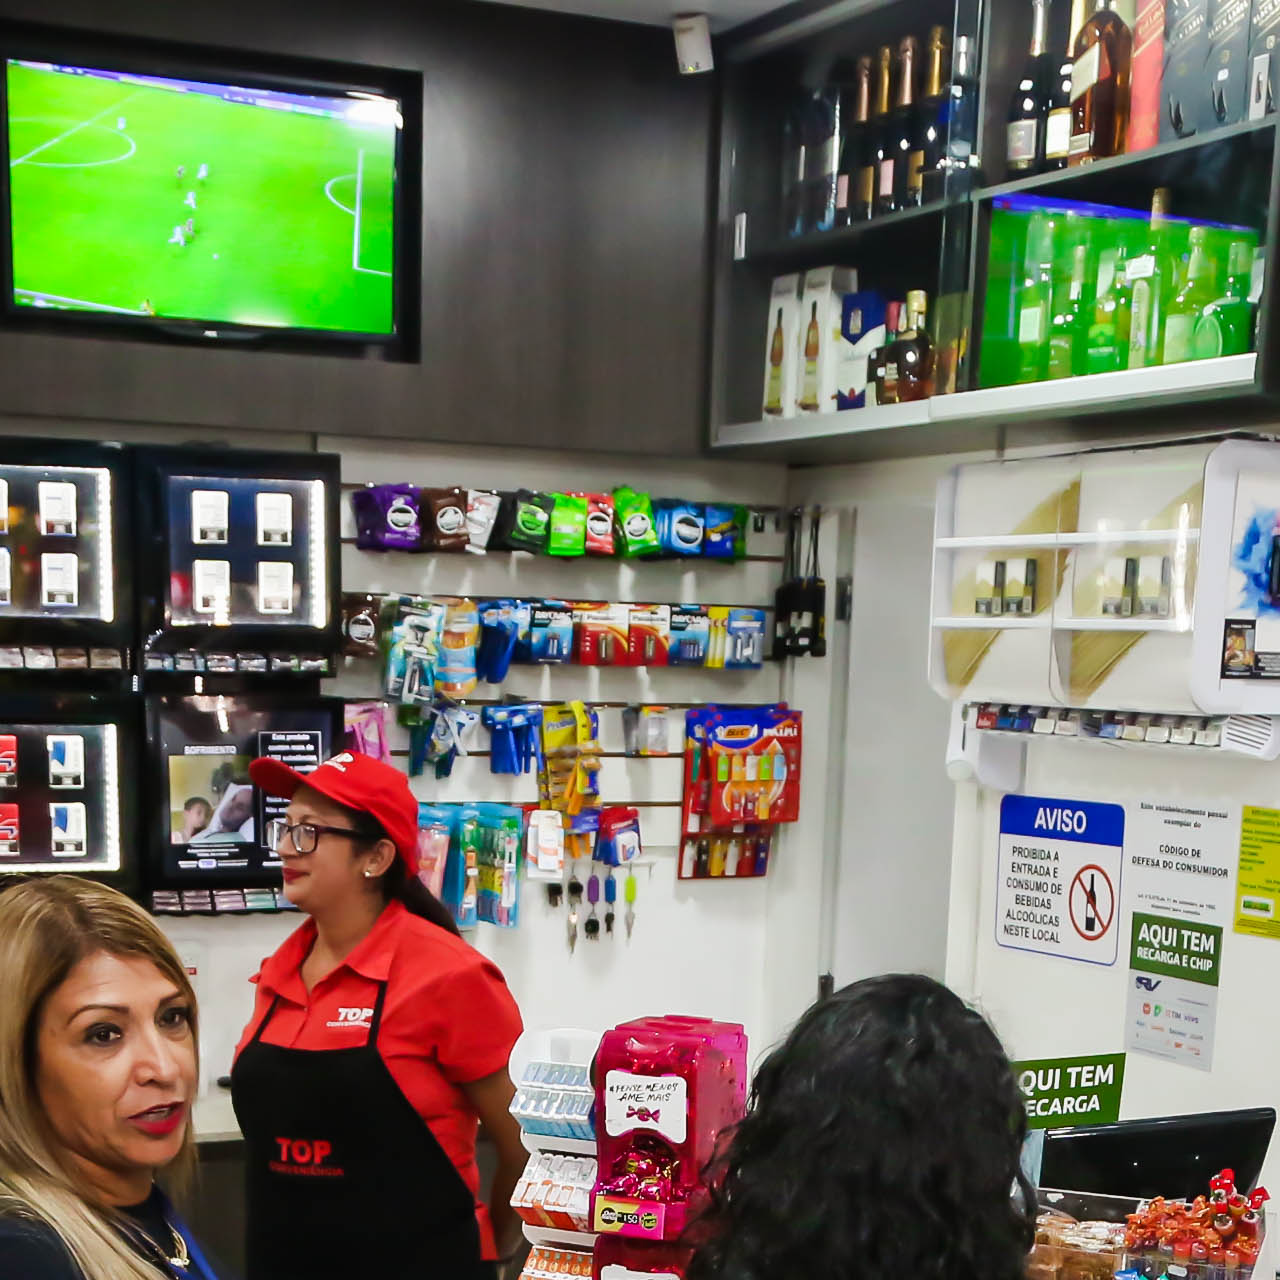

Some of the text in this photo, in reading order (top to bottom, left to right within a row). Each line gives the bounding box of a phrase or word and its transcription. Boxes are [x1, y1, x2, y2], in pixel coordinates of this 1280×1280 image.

[1034, 807, 1087, 834] AVISO
[1012, 845, 1060, 862] PROIBIDA A
[1159, 843, 1202, 858] CÓDIGO DE
[1011, 862, 1059, 878] ENTRADA E
[1131, 856, 1229, 878] DEFESA DO CONSUMIDOR
[1006, 877, 1063, 895] CONSUMO DE
[1015, 894, 1052, 909] BEBIDAS
[1003, 924, 1061, 944] NESTE LOCAL
[1138, 922, 1178, 948] AQUI
[1181, 930, 1215, 954] TEM
[1136, 946, 1213, 972] RECARGA E CHIP
[337, 1007, 374, 1021] TOP
[1019, 1064, 1114, 1096] QUI TEM
[617, 1092, 672, 1103] AME MAIS
[1025, 1094, 1100, 1117] ECARGA
[275, 1136, 332, 1165] TOP
